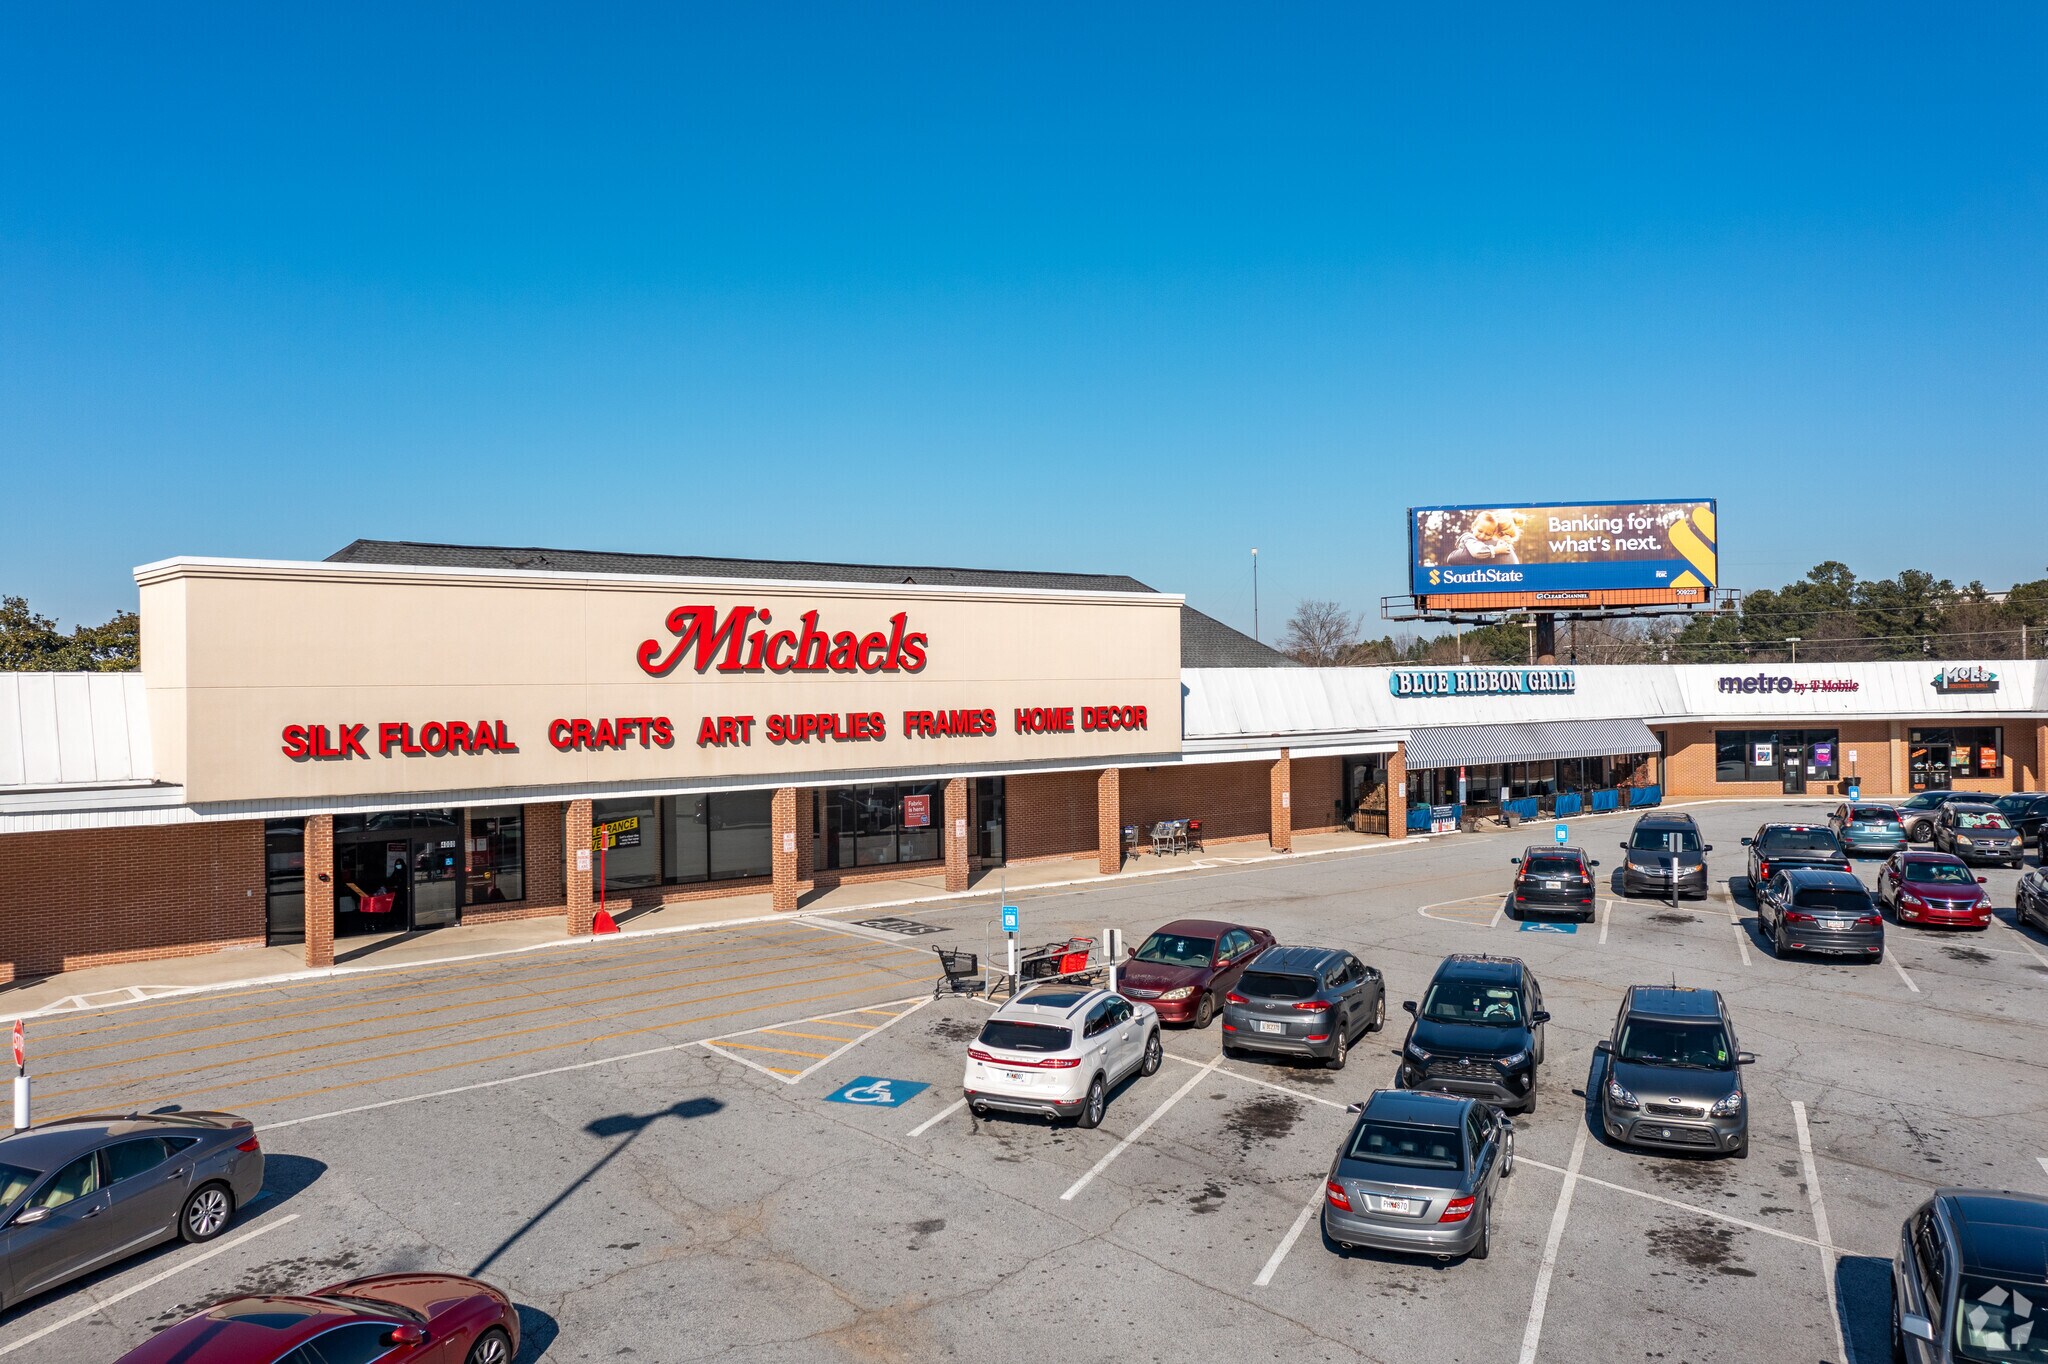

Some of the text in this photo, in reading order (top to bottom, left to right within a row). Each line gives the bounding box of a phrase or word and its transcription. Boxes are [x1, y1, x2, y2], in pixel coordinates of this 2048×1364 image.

[1549, 512, 1652, 535] Banking for
[1549, 532, 1662, 554] what's next.
[1443, 569, 1523, 584] SouthState
[637, 605, 928, 674] Michaels
[1397, 670, 1576, 694] BLUE RIBBON GRILL
[1719, 673, 1793, 693] metro
[1794, 680, 1808, 694] by
[282, 705, 1149, 758] SILK FLORAL CRAFTS ART SUPPLIES FRAMES HOME DECOR
[592, 819, 635, 837] LERANCE
